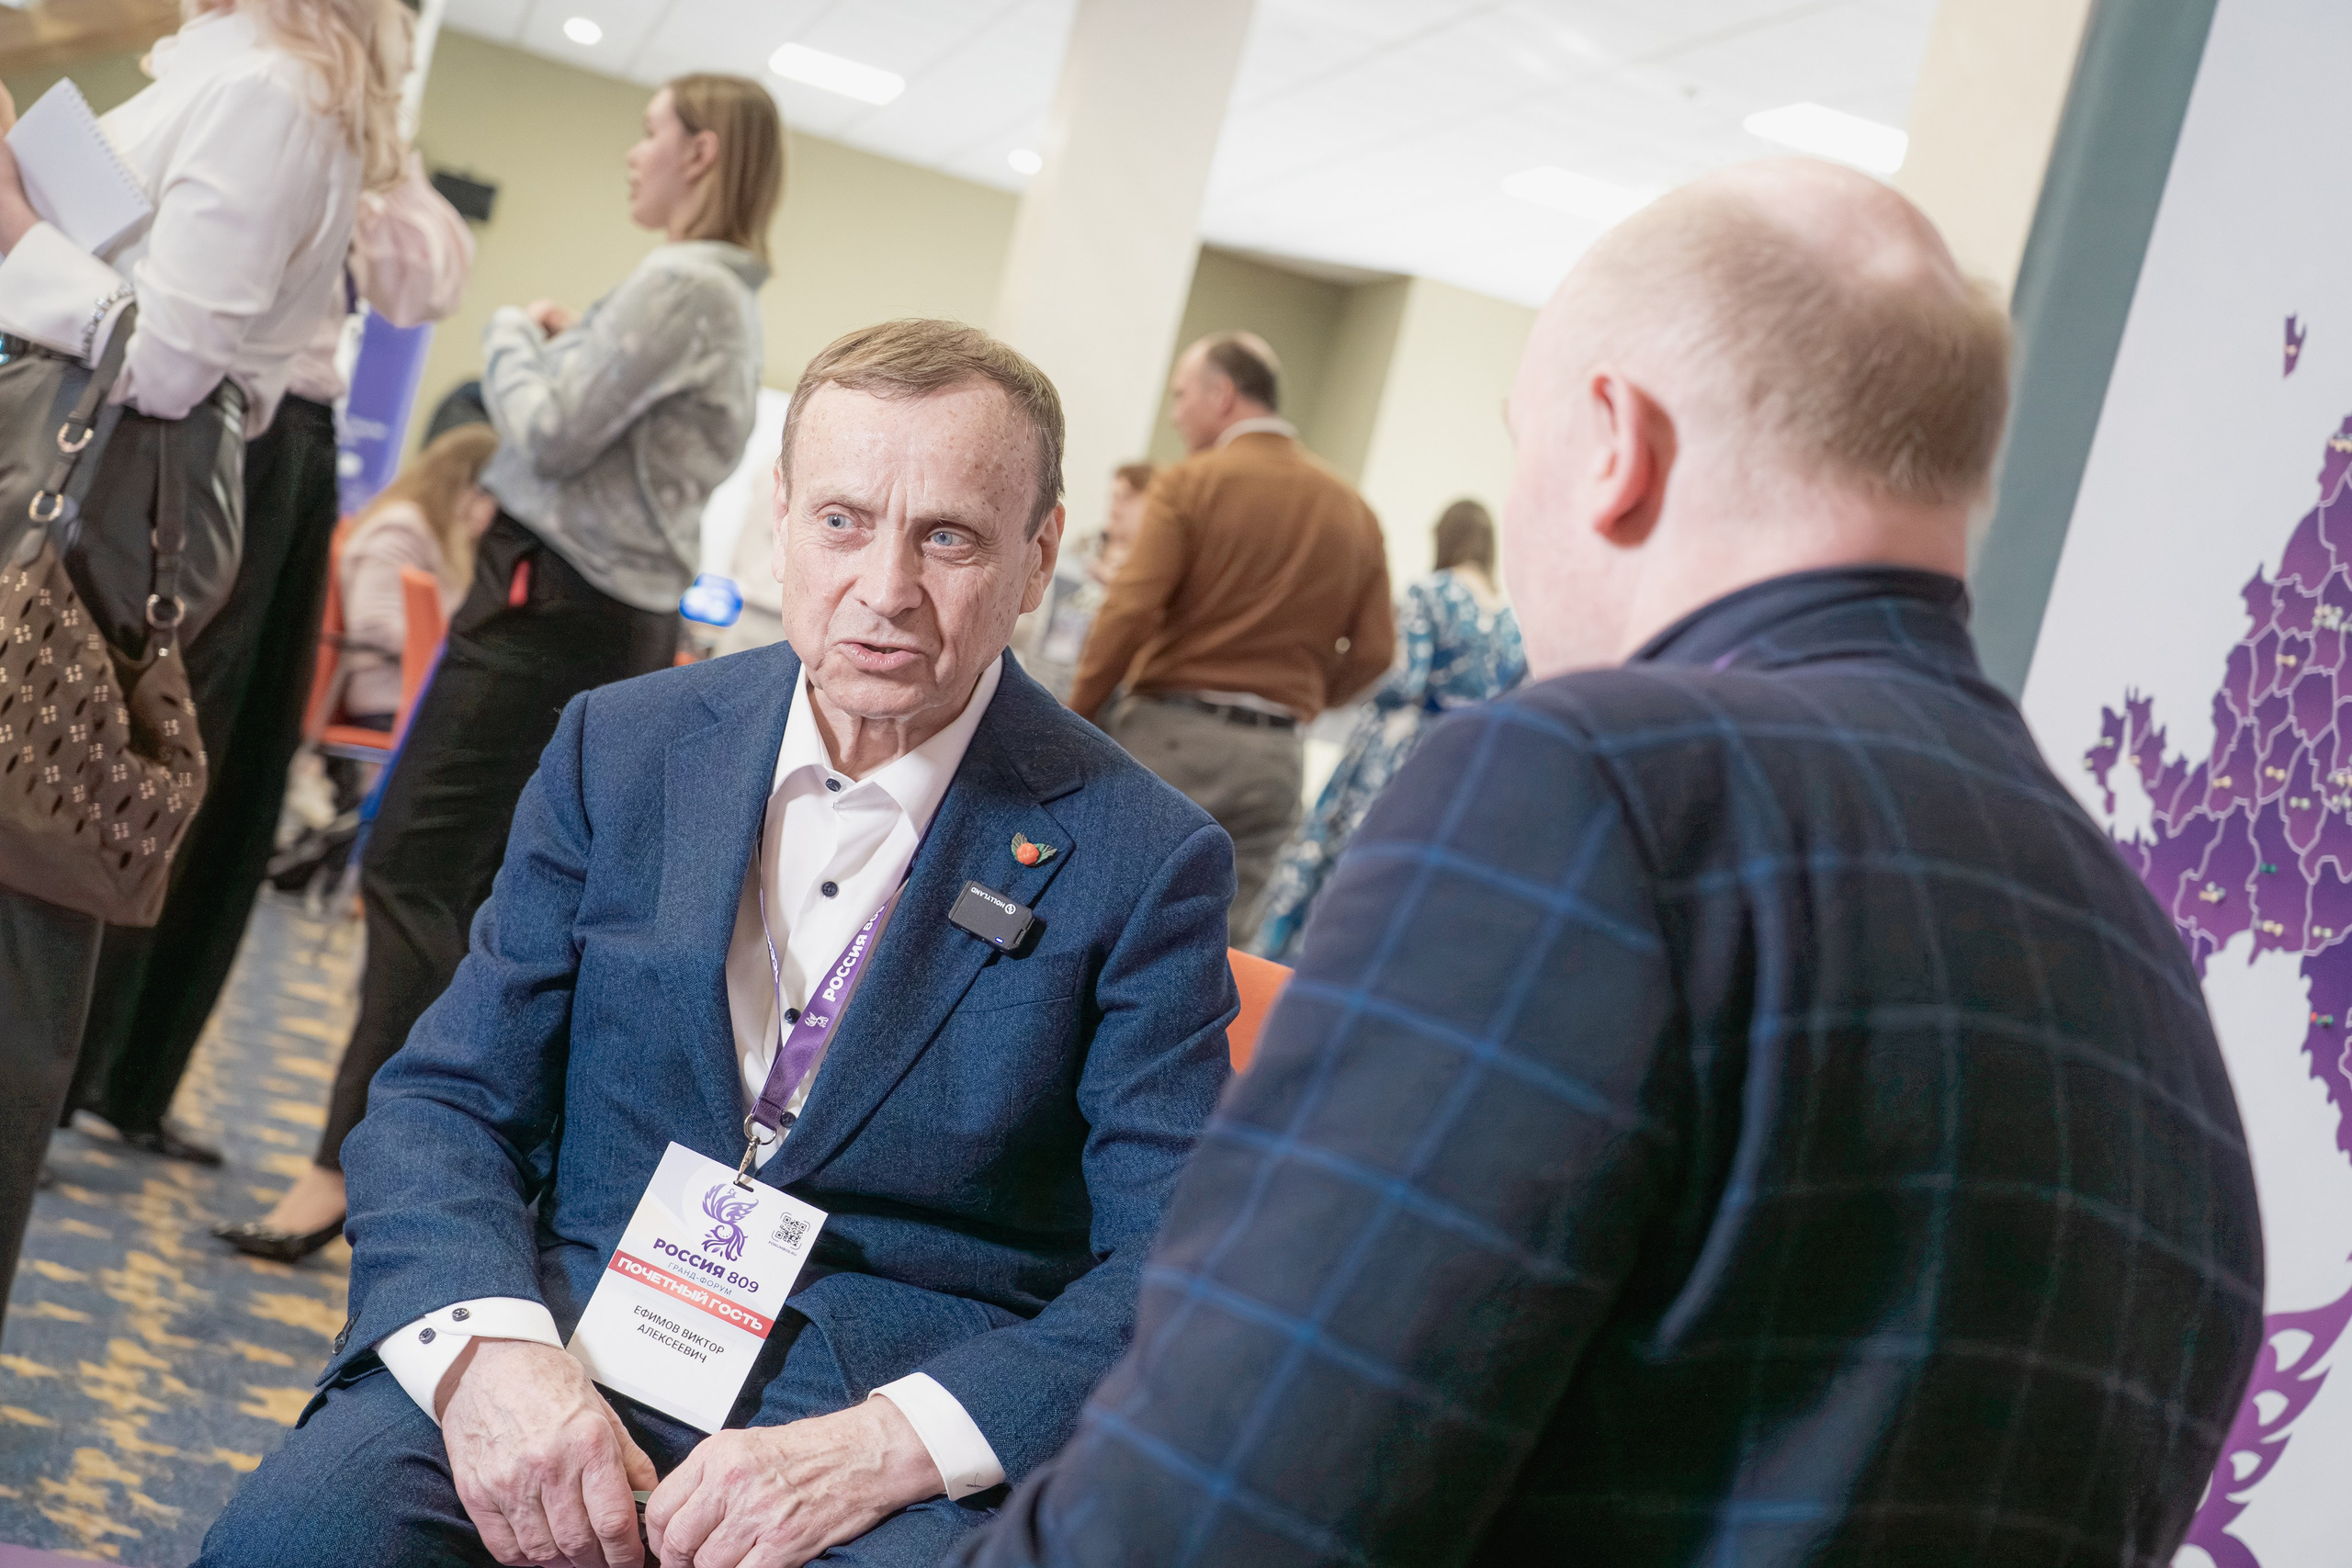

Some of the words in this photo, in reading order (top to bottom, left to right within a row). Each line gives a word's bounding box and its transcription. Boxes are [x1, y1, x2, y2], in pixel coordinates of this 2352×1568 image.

[970, 886, 1006, 908] HOLLYLAND
[822, 934, 867, 1002] РОССИЯ
[652, 1237, 726, 1279] РОССИЯ
[727, 1271, 760, 1294] 809
[667, 1261, 732, 1296] ГРАНД-ФОРУМ
[617, 1256, 709, 1310] ПОЧЕТНЫЙ
[707, 1297, 763, 1331] ГОСТЬ
[633, 1304, 680, 1334] ЕФИМОВ
[681, 1325, 725, 1356] ВИКТОР
[637, 1323, 707, 1364] АЛЕКСЕЕВИЧ
